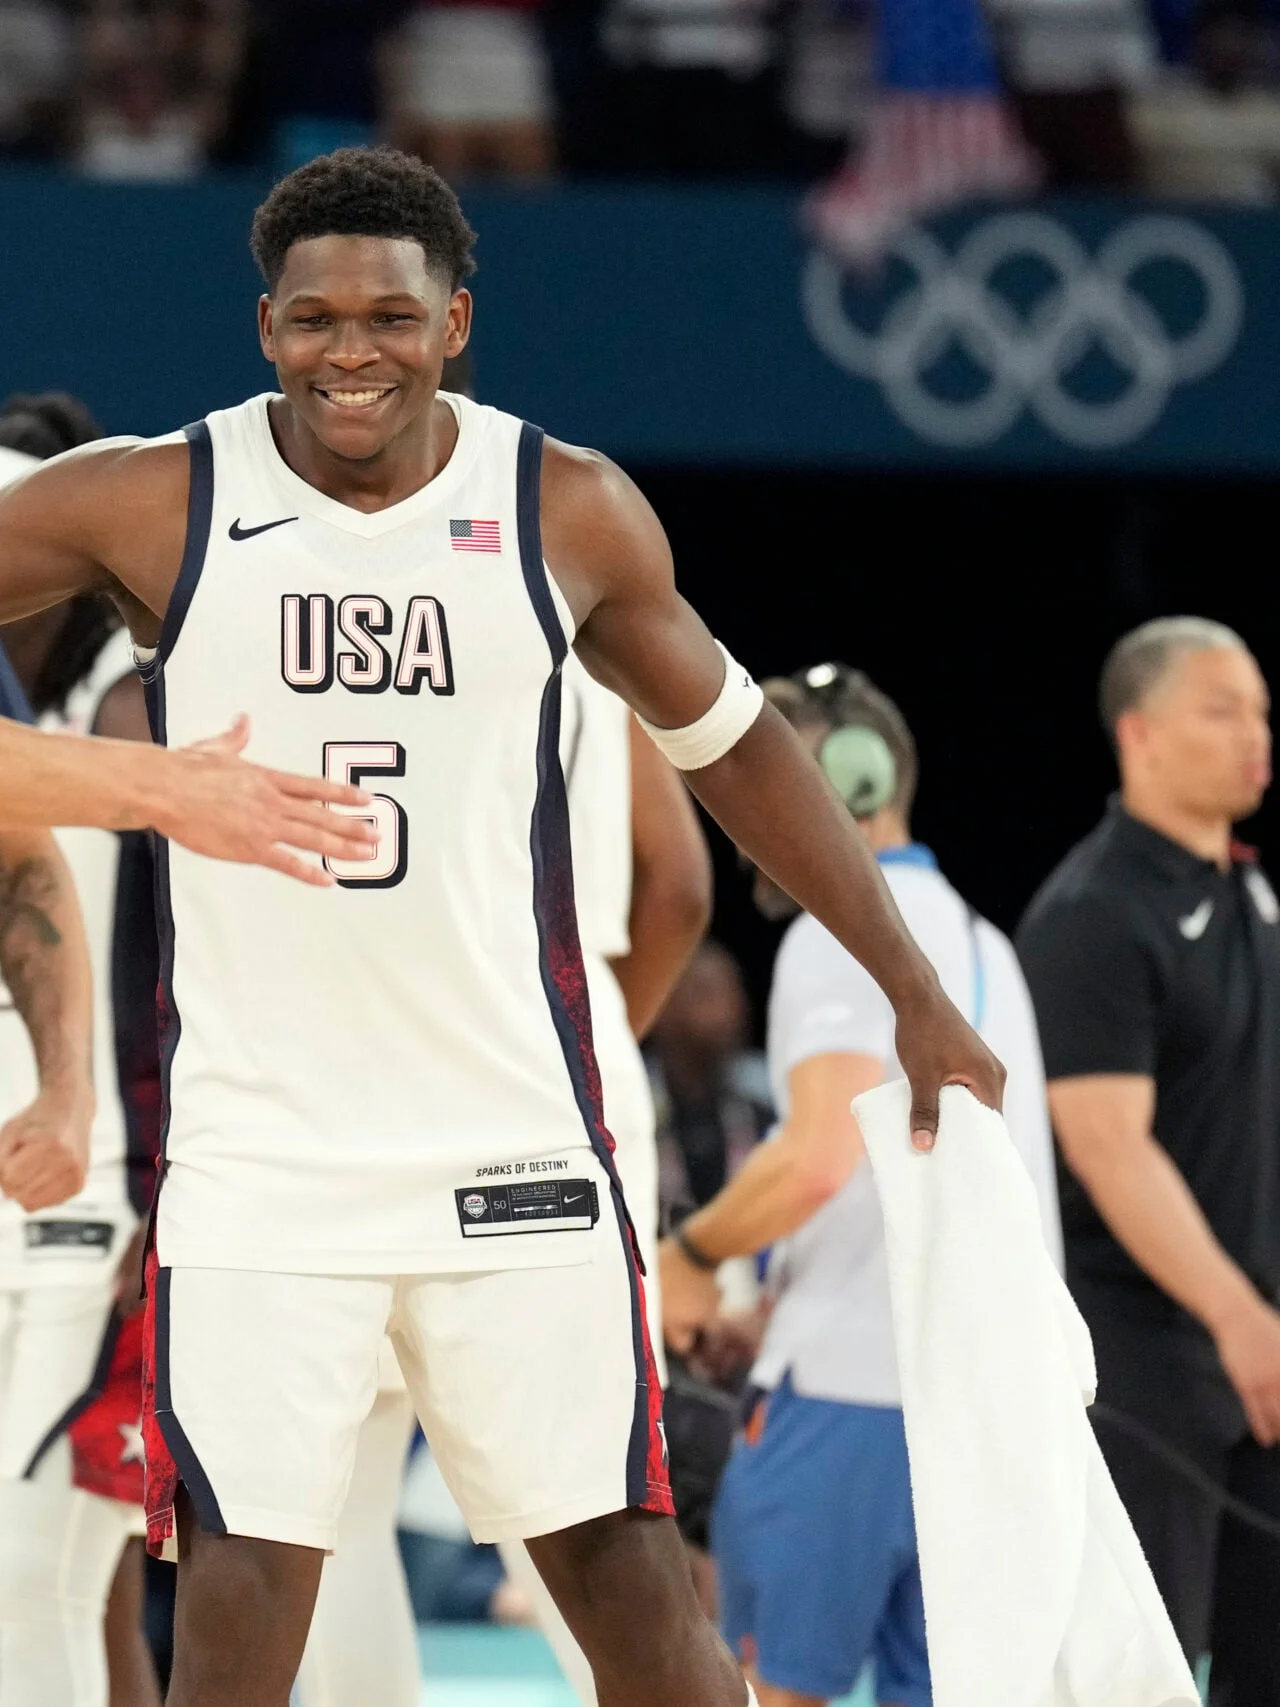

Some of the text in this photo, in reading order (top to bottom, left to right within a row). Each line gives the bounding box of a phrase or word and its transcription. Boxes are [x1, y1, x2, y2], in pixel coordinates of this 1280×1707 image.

[280, 593, 456, 697] USA
[322, 741, 409, 889] 5
[475, 1160, 568, 1177] SPARKS OF DESTINY
[510, 1184, 556, 1193] ENGINEERED
[493, 1200, 507, 1210] 50
